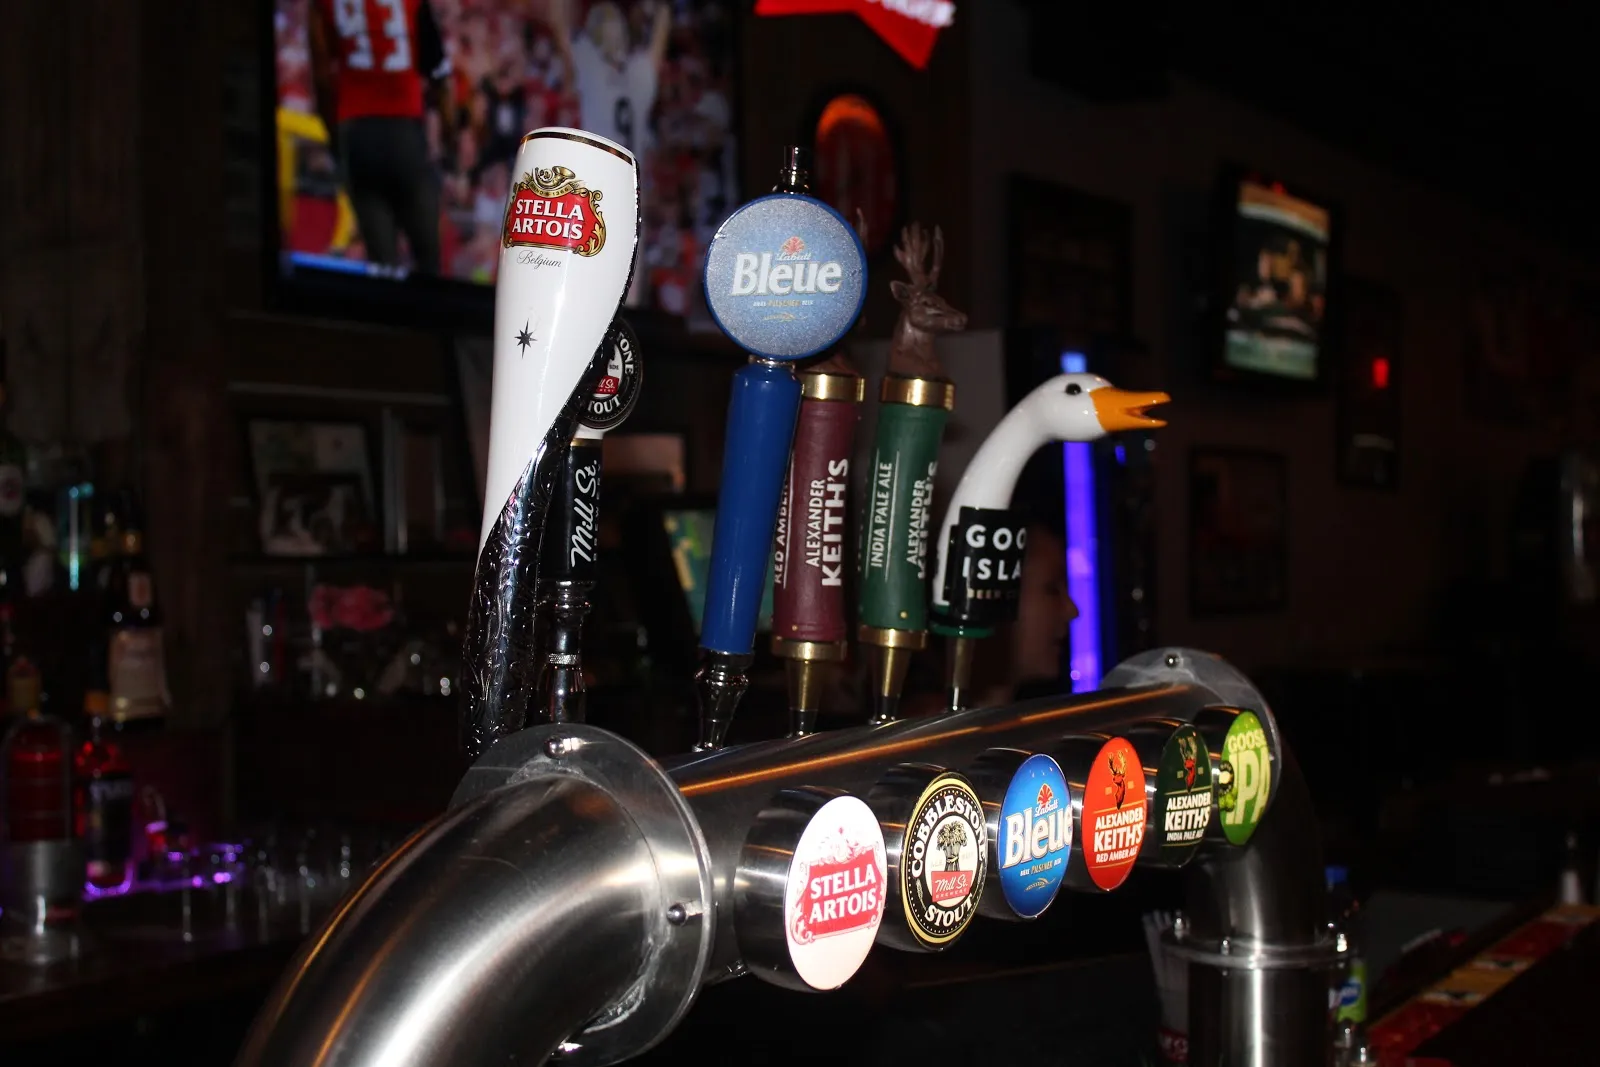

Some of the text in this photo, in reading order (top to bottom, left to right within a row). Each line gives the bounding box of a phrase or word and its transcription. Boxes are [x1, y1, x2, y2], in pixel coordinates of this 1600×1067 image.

[515, 199, 584, 220] STELLA
[512, 218, 583, 239] ARTOIS
[516, 250, 562, 269] Belgium
[731, 252, 843, 296] Bleue
[571, 460, 598, 567] Mill St.
[805, 479, 827, 568] ALEXANDER
[821, 458, 848, 587] KEITH'S
[870, 462, 893, 568] INDIA PALE ALE
[906, 479, 926, 566] ALEXANDER
[1034, 799, 1059, 817] Labatt
[1166, 792, 1211, 811] ALEXANDER
[1095, 807, 1144, 830] ALEXANDER
[1165, 806, 1211, 831] KEITH'S
[912, 795, 986, 878] COBBLESTONE
[1002, 805, 1073, 868] Bleue
[1094, 822, 1144, 852] KEITH'S
[1166, 830, 1182, 841] INDIA
[1183, 829, 1196, 841] PALE
[1096, 845, 1139, 863] RED AMBER ALE
[811, 864, 876, 899] STELLA
[935, 876, 957, 893] Mill
[809, 887, 877, 924] ARTOIS
[925, 893, 973, 927] STOUT
